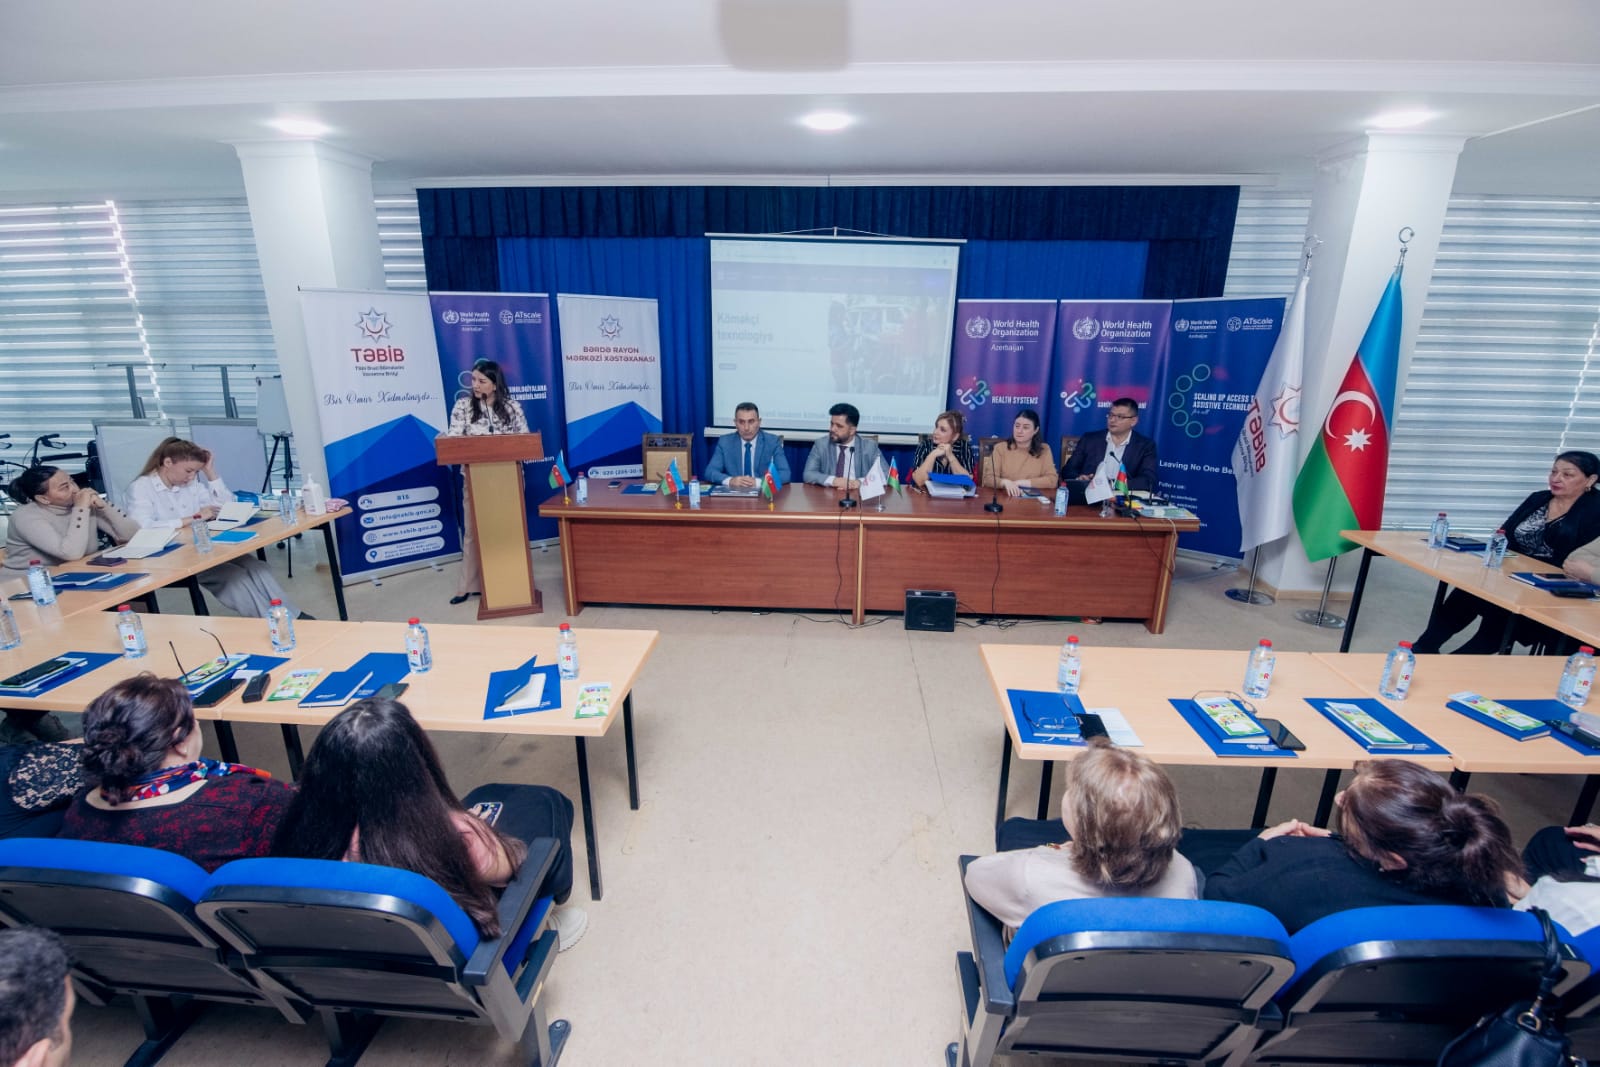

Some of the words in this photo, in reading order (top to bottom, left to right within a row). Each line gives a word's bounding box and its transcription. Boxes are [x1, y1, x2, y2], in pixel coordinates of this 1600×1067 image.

[993, 320, 1014, 328] World
[1016, 320, 1040, 329] Health
[1102, 321, 1125, 330] World
[1127, 321, 1152, 330] Health
[1243, 317, 1273, 325] ATscale
[992, 328, 1039, 337] Organization
[1101, 330, 1151, 339] Organization
[613, 346, 639, 354] RAYON
[991, 344, 1024, 352] Azerbaijan
[1099, 346, 1134, 355] Azerbaijan
[351, 345, 405, 363] TƏBİB
[992, 395, 1011, 404] HEALTH
[1012, 396, 1039, 405] SYSTEMS
[1194, 393, 1217, 401] SCALING
[1227, 394, 1249, 402] ACCESS
[1159, 459, 1189, 471] Leaving
[1190, 463, 1202, 471] No
[1203, 464, 1220, 473] One
